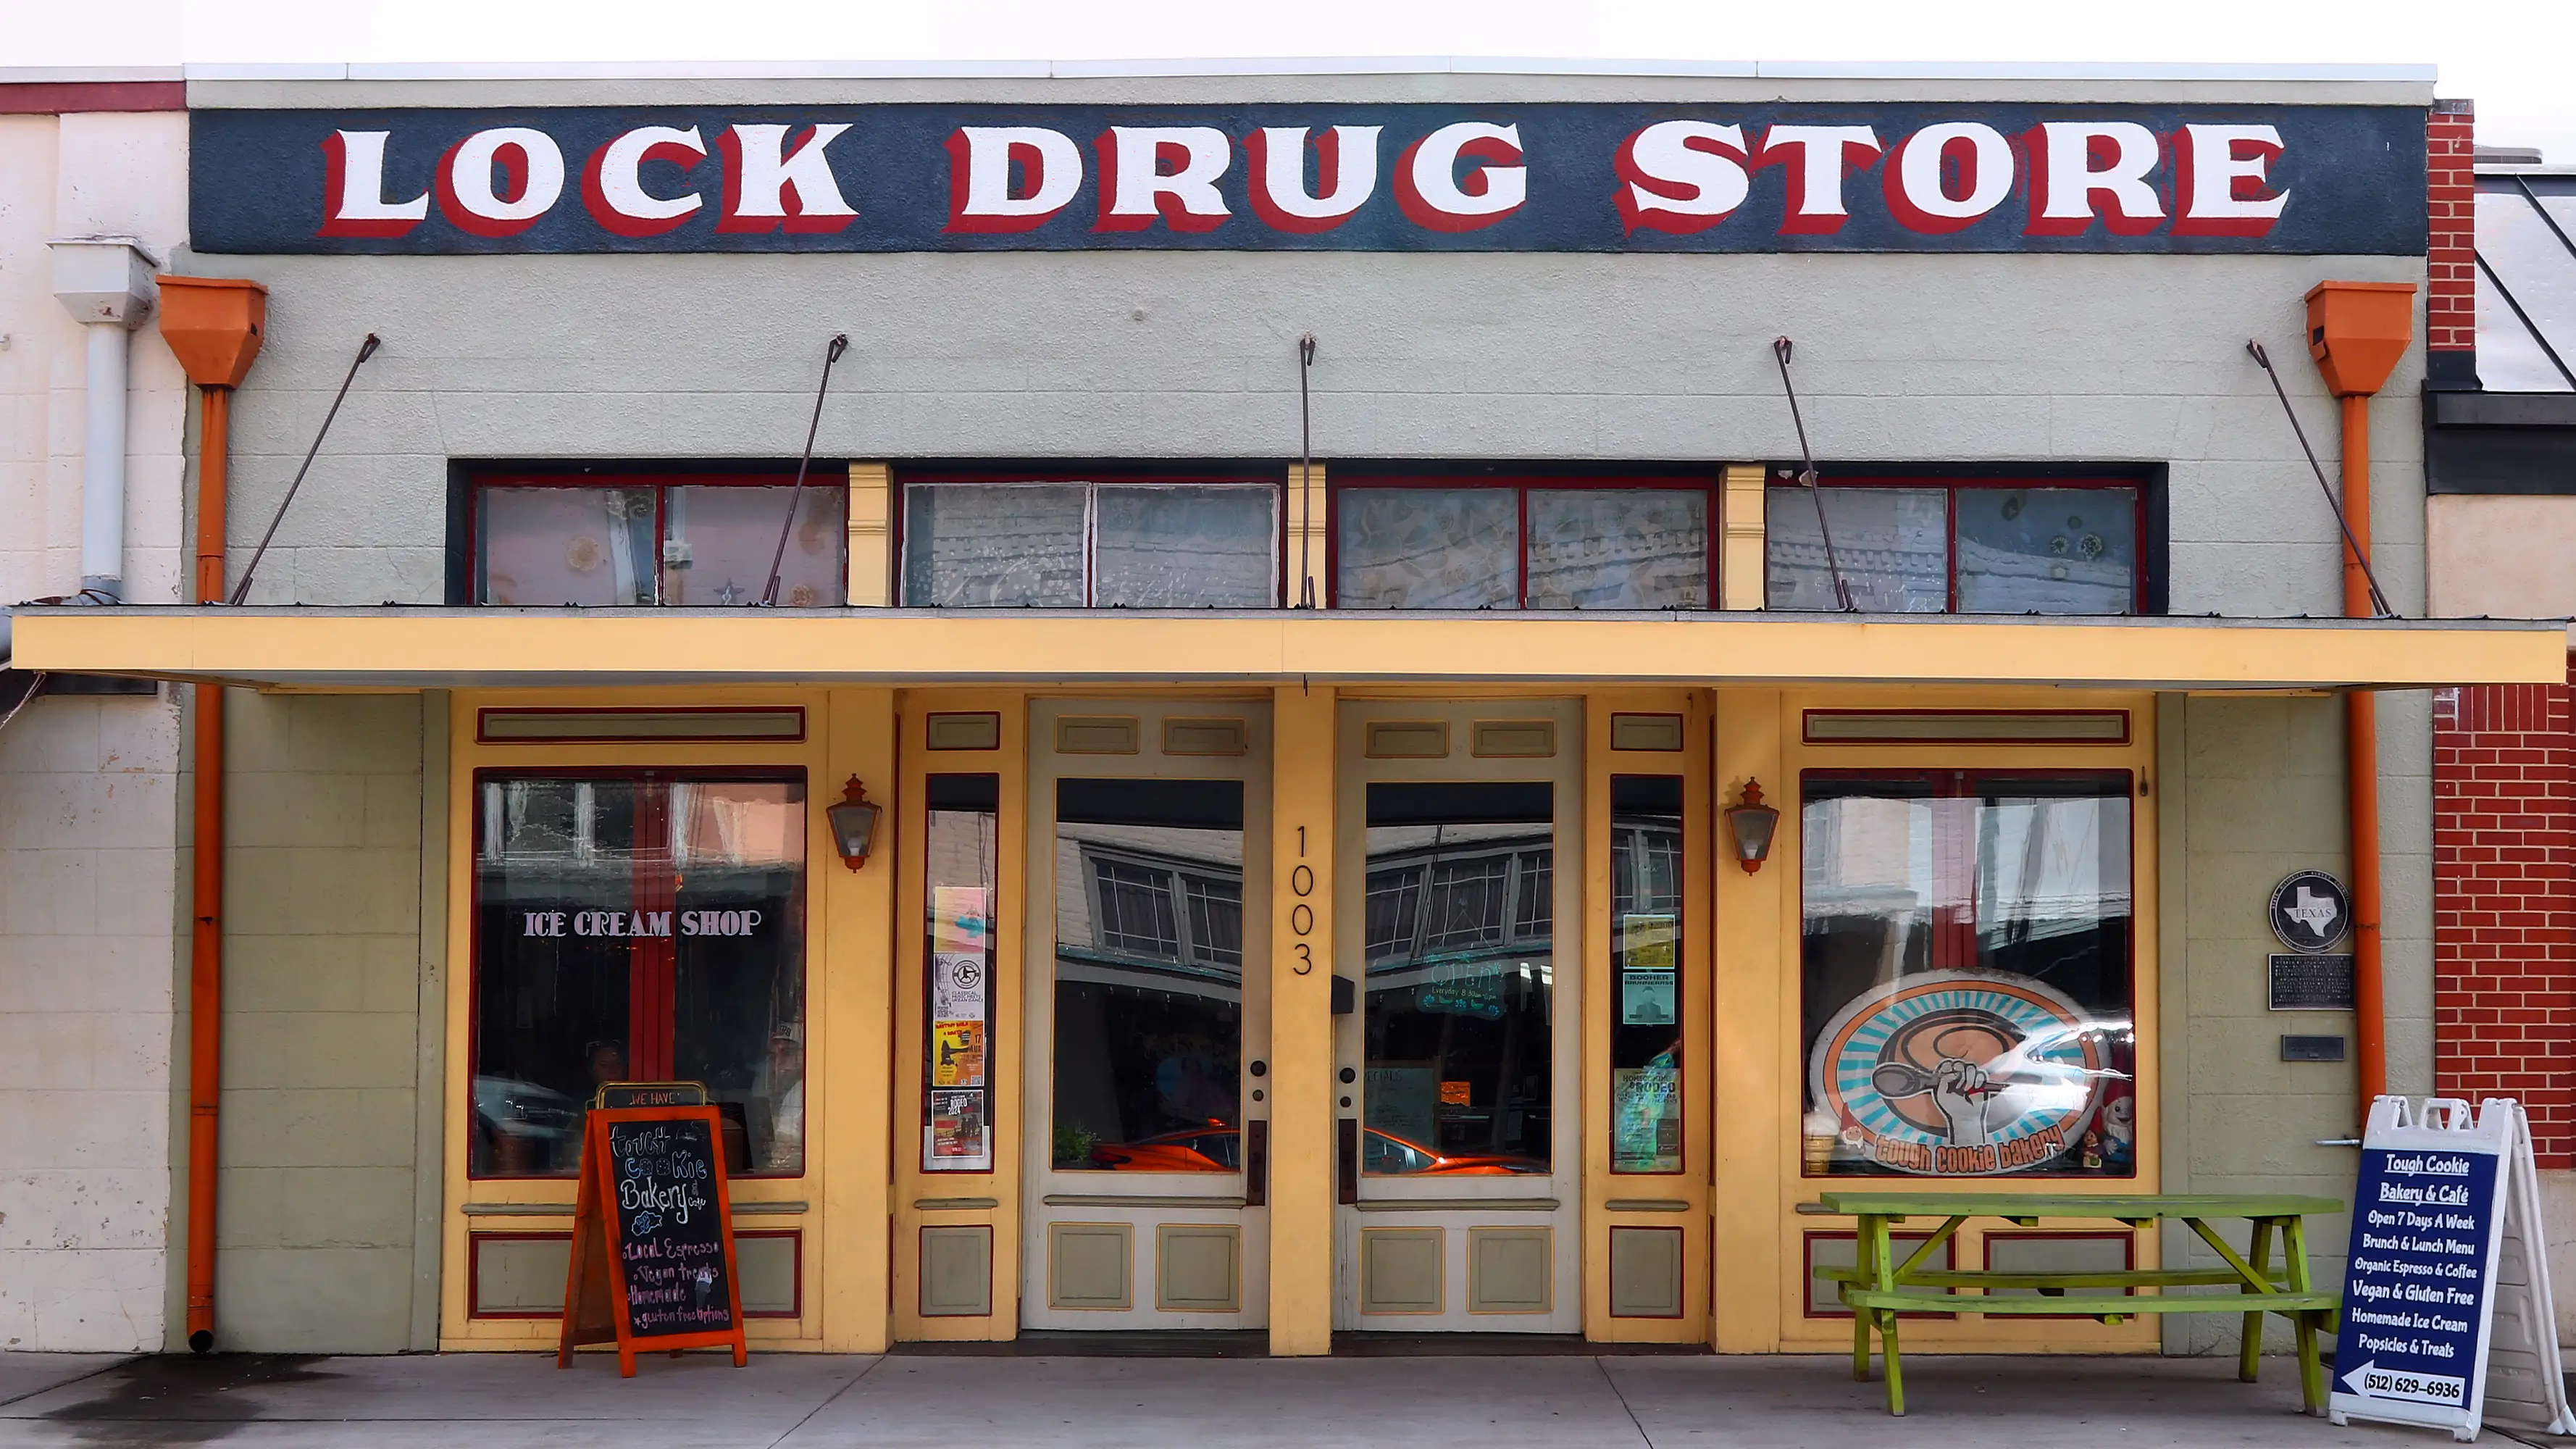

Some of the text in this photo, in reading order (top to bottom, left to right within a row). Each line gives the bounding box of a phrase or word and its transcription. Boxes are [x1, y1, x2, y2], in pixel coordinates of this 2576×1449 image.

[316, 120, 2291, 237] LOCK DRUG STORE
[1291, 824, 1314, 976] 1003
[523, 909, 761, 937] ICE CREAM SHOP
[2294, 909, 2332, 918] TEXAS
[1431, 986, 1459, 996] Everyday
[975, 1034, 981, 1044] 17
[1364, 1070, 1402, 1082] ECIALS
[1636, 1082, 1676, 1093] RODEO
[632, 1093, 675, 1105] WE HAVE
[1875, 1124, 2065, 1173] tough cookie bakery
[2386, 1153, 2470, 1177] Tough Cookie
[620, 1176, 688, 1224] Bakery
[2380, 1182, 2469, 1206] Bakery & Café
[2368, 1209, 2475, 1232] Open 7 Days A Week
[624, 1237, 719, 1261] Local Espresso
[2362, 1233, 2475, 1256] Brunch & Lunch Menu
[637, 1263, 719, 1286] Vegan treats
[2355, 1257, 2477, 1279] Organic Espresso & Coffee
[630, 1282, 687, 1306] Homemade
[2353, 1279, 2475, 1306] Vegan & Gluten Free
[2351, 1307, 2468, 1333] Homemade Ice Cream
[2359, 1333, 2454, 1358] Popsicles & Treats
[2364, 1372, 2393, 1392] (512)
